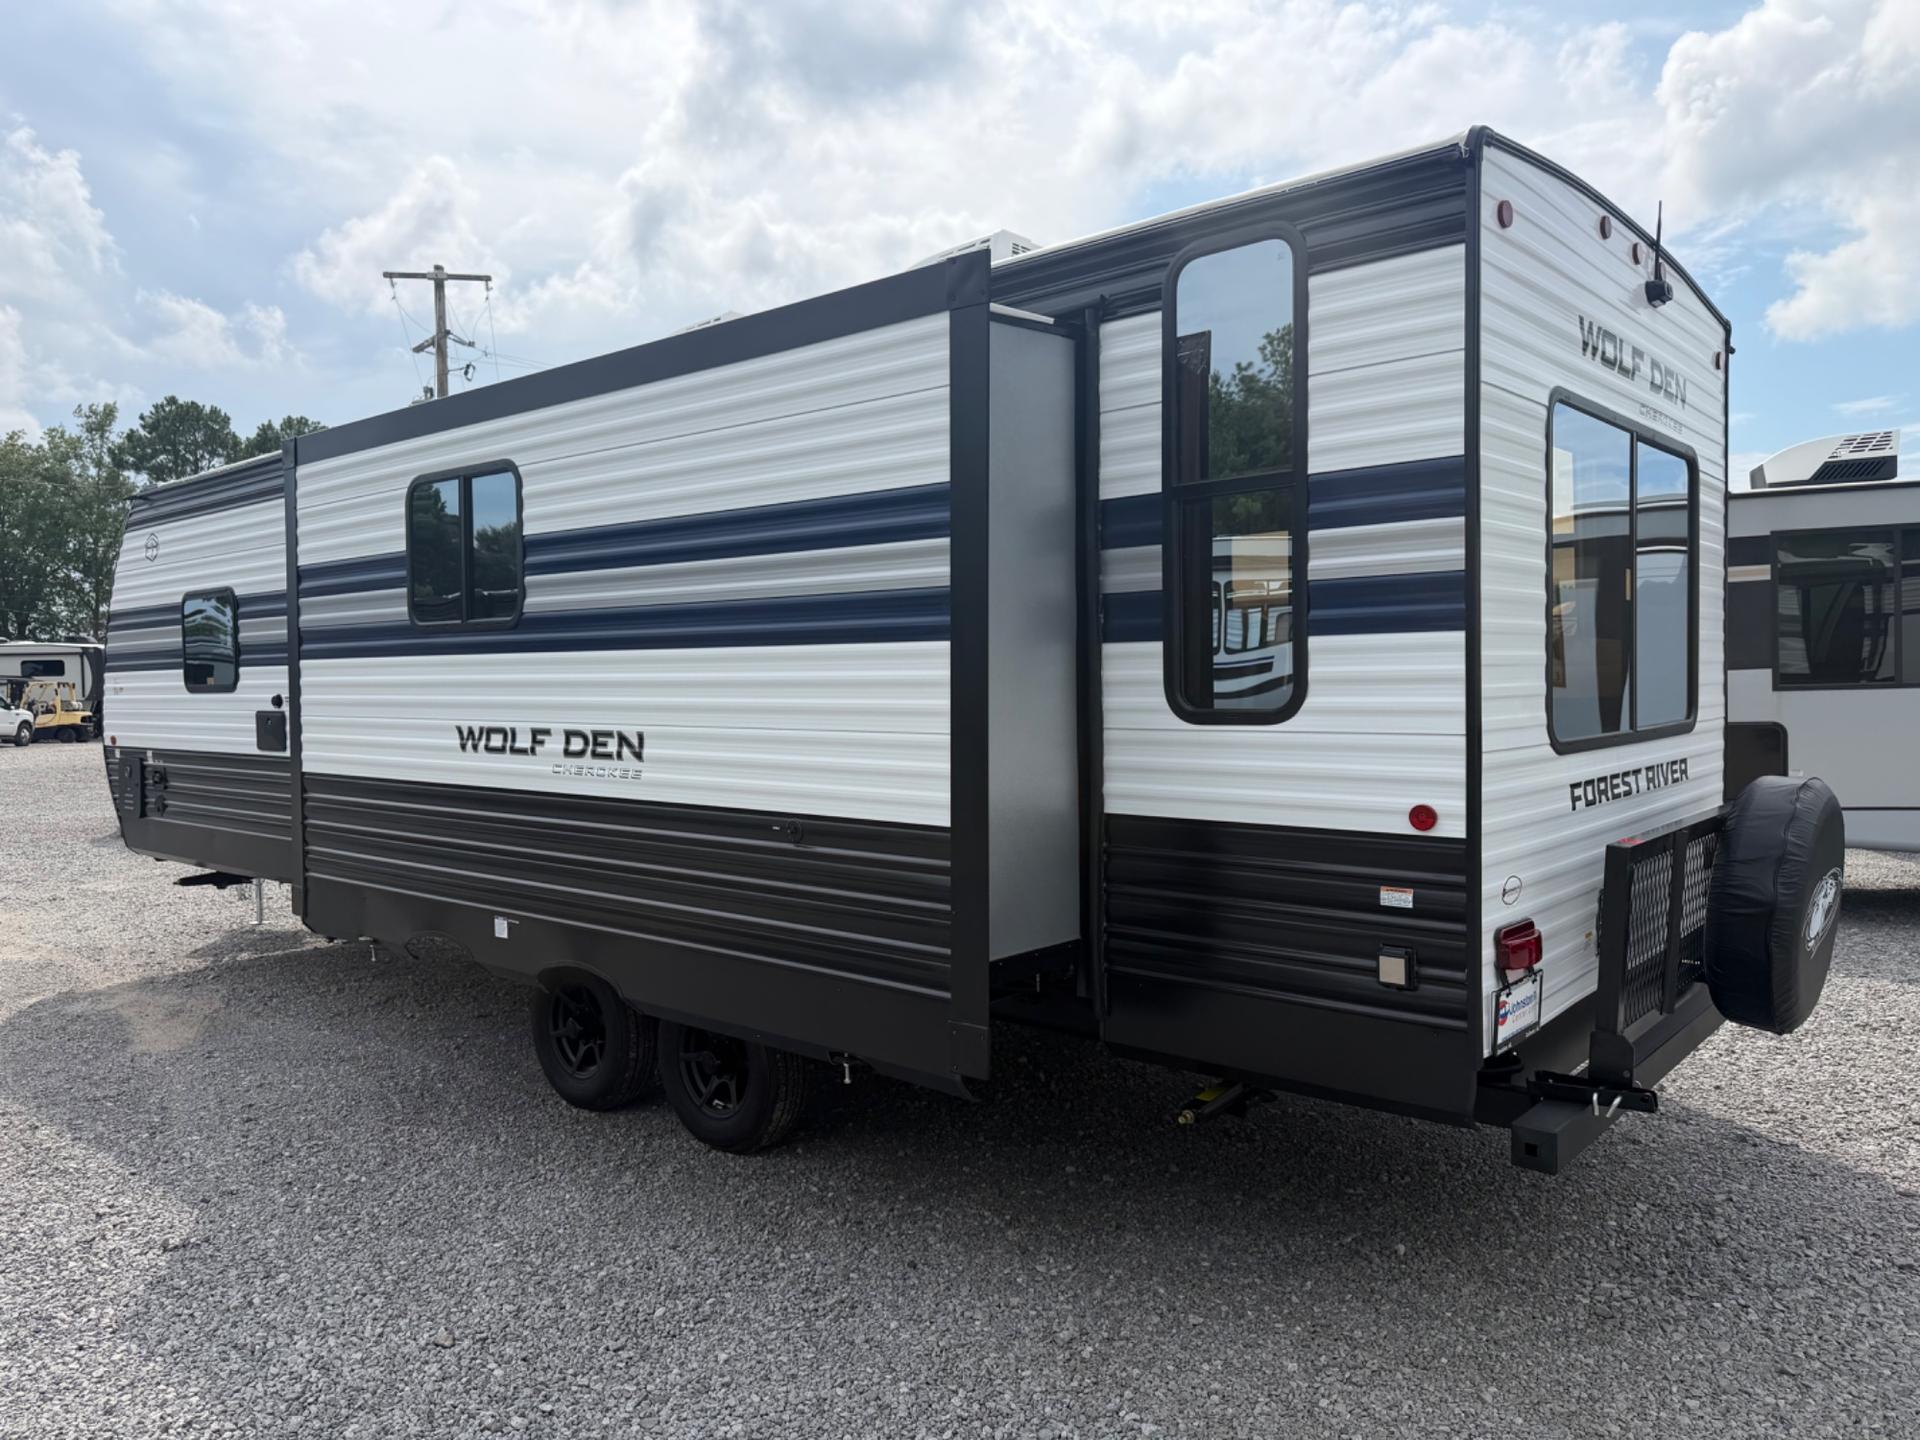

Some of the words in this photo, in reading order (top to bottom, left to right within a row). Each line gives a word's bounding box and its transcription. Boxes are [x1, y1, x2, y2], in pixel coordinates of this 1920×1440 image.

[1578, 314, 1645, 382] WOLF
[1649, 356, 1687, 411] DEN
[455, 725, 553, 757] WOLF
[563, 728, 645, 763] DEN
[551, 763, 643, 780] CHEROKEE
[1569, 767, 1643, 811] FOREST
[1644, 757, 1689, 791] RIVER
